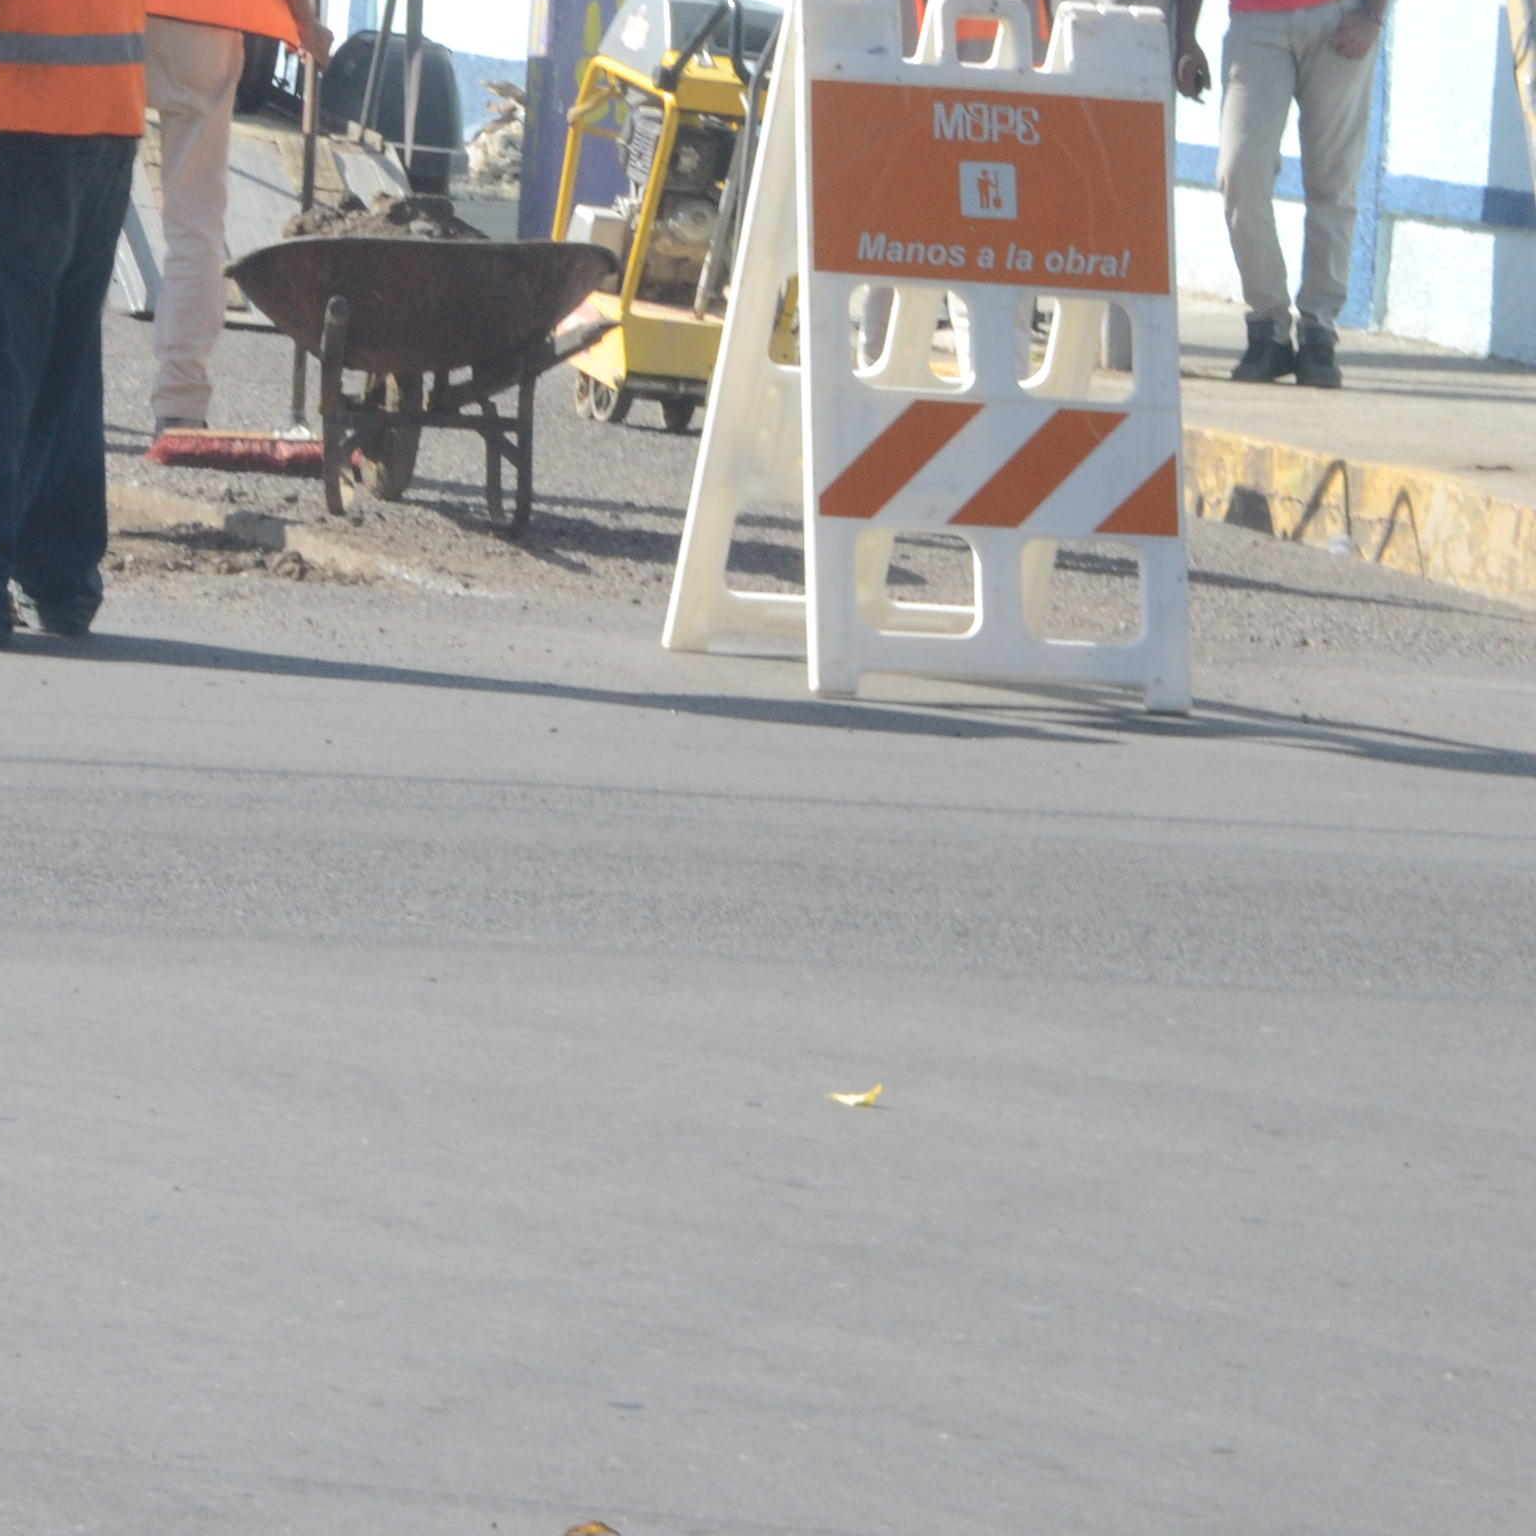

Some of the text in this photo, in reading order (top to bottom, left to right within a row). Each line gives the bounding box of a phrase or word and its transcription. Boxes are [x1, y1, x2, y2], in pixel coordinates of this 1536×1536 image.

[857, 231, 1131, 277] Manos a la obra!
